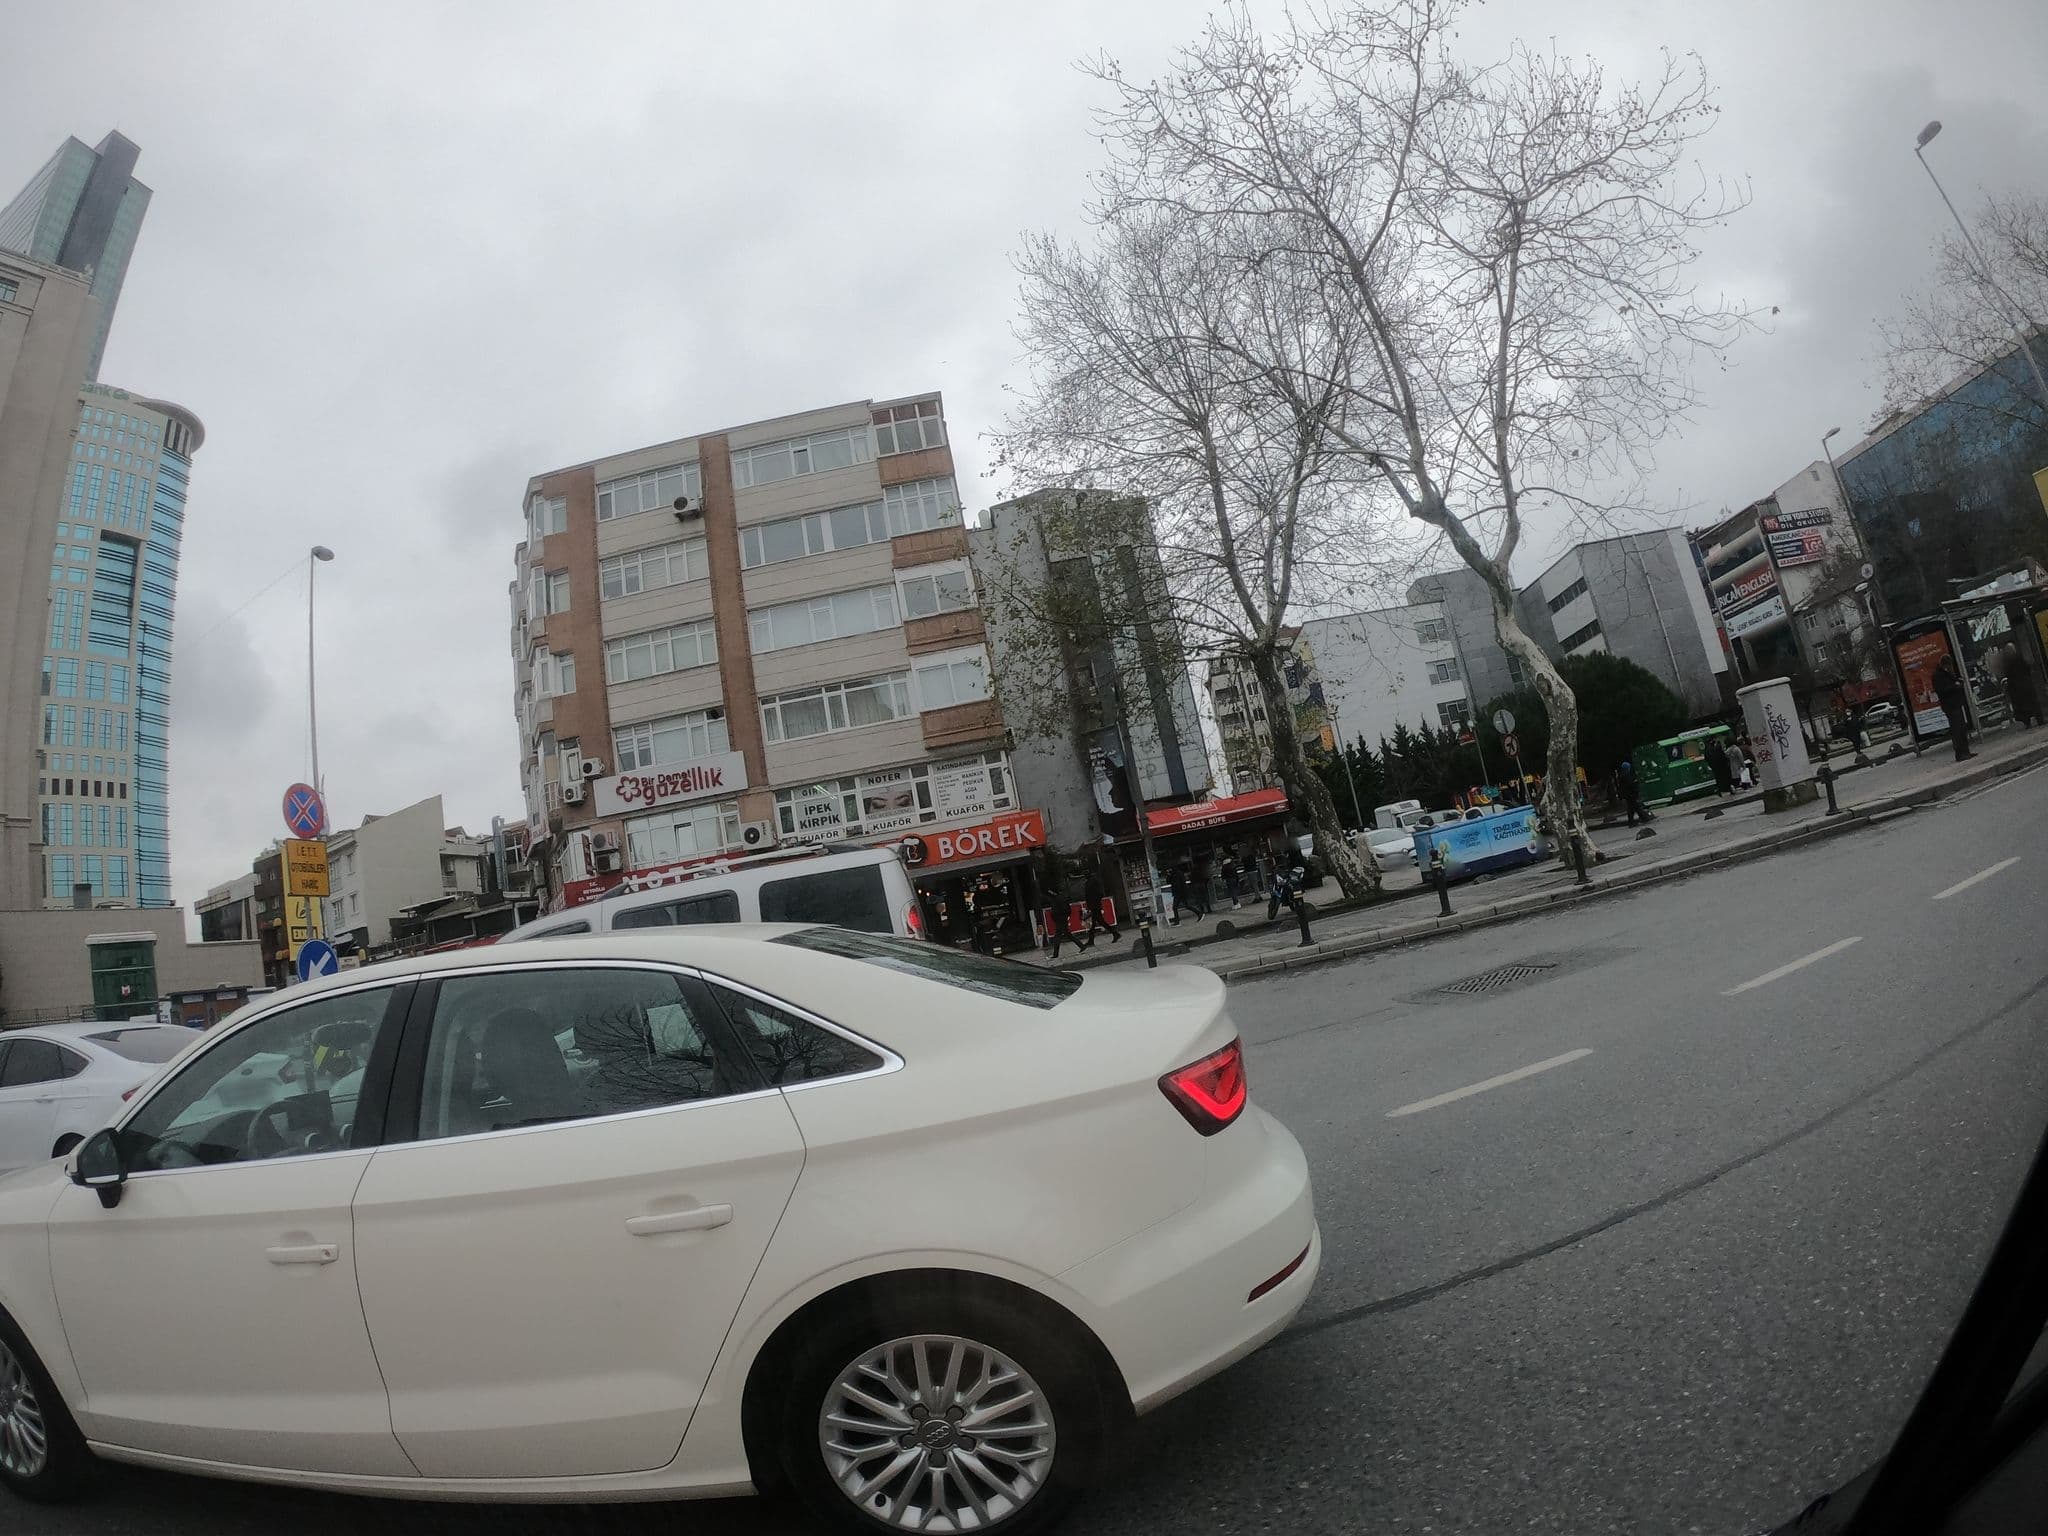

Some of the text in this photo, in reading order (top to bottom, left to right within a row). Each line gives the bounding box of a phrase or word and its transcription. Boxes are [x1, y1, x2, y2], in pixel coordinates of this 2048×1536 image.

[867, 772, 901, 785] NOTER
[642, 766, 724, 806] güzellik
[804, 802, 832, 816] İPEK
[945, 803, 985, 817] KUAFÖR
[799, 813, 841, 830] KİRPİK
[872, 817, 912, 831] KUAFÖR
[937, 821, 1038, 859] BÖREK
